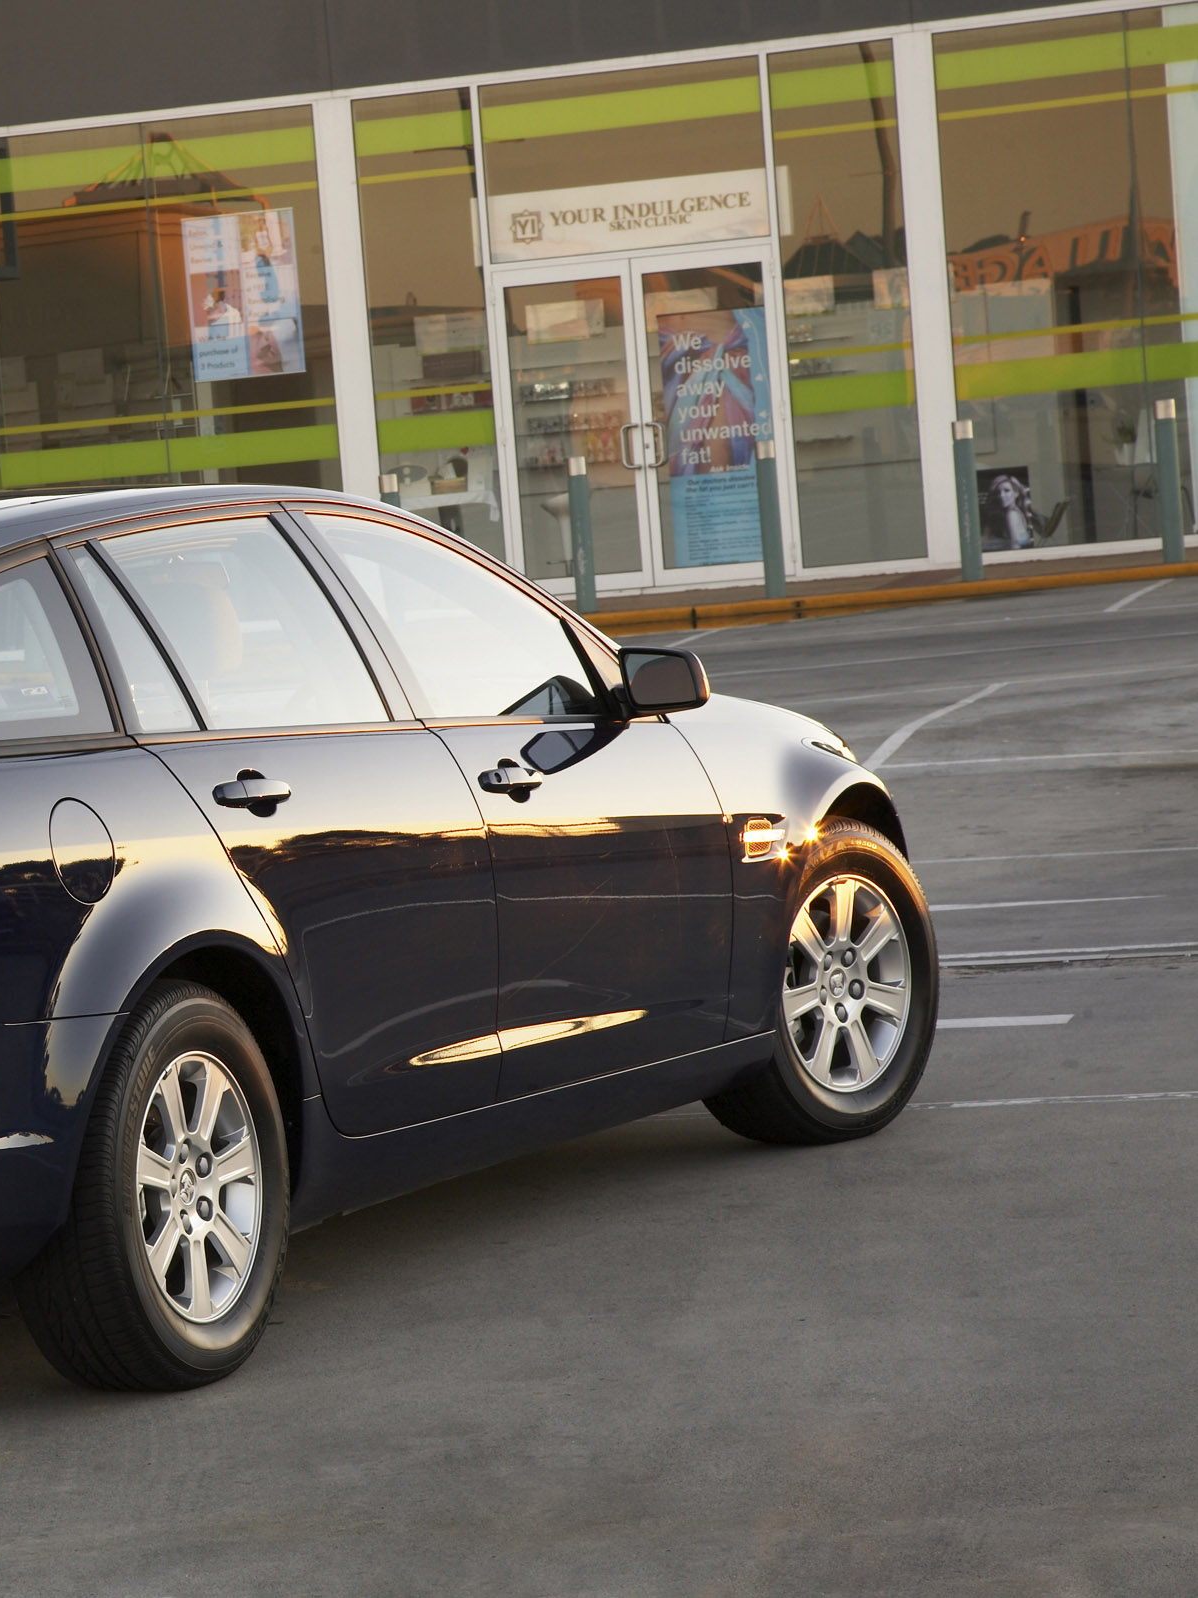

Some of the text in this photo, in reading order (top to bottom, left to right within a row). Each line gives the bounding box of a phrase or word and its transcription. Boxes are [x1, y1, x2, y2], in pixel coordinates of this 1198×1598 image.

[549, 191, 752, 227] YOUR INDULGENCE
[515, 218, 536, 236] YI
[608, 213, 692, 232] SKIN CLINIC
[199, 345, 239, 358] purchase of
[672, 334, 702, 351] We
[207, 361, 236, 370] Products
[674, 352, 752, 375] dissolve
[676, 380, 726, 398] away
[677, 402, 721, 424] your
[679, 420, 773, 443] unwanted
[681, 446, 712, 465] fat!
[709, 465, 724, 474] Ask
